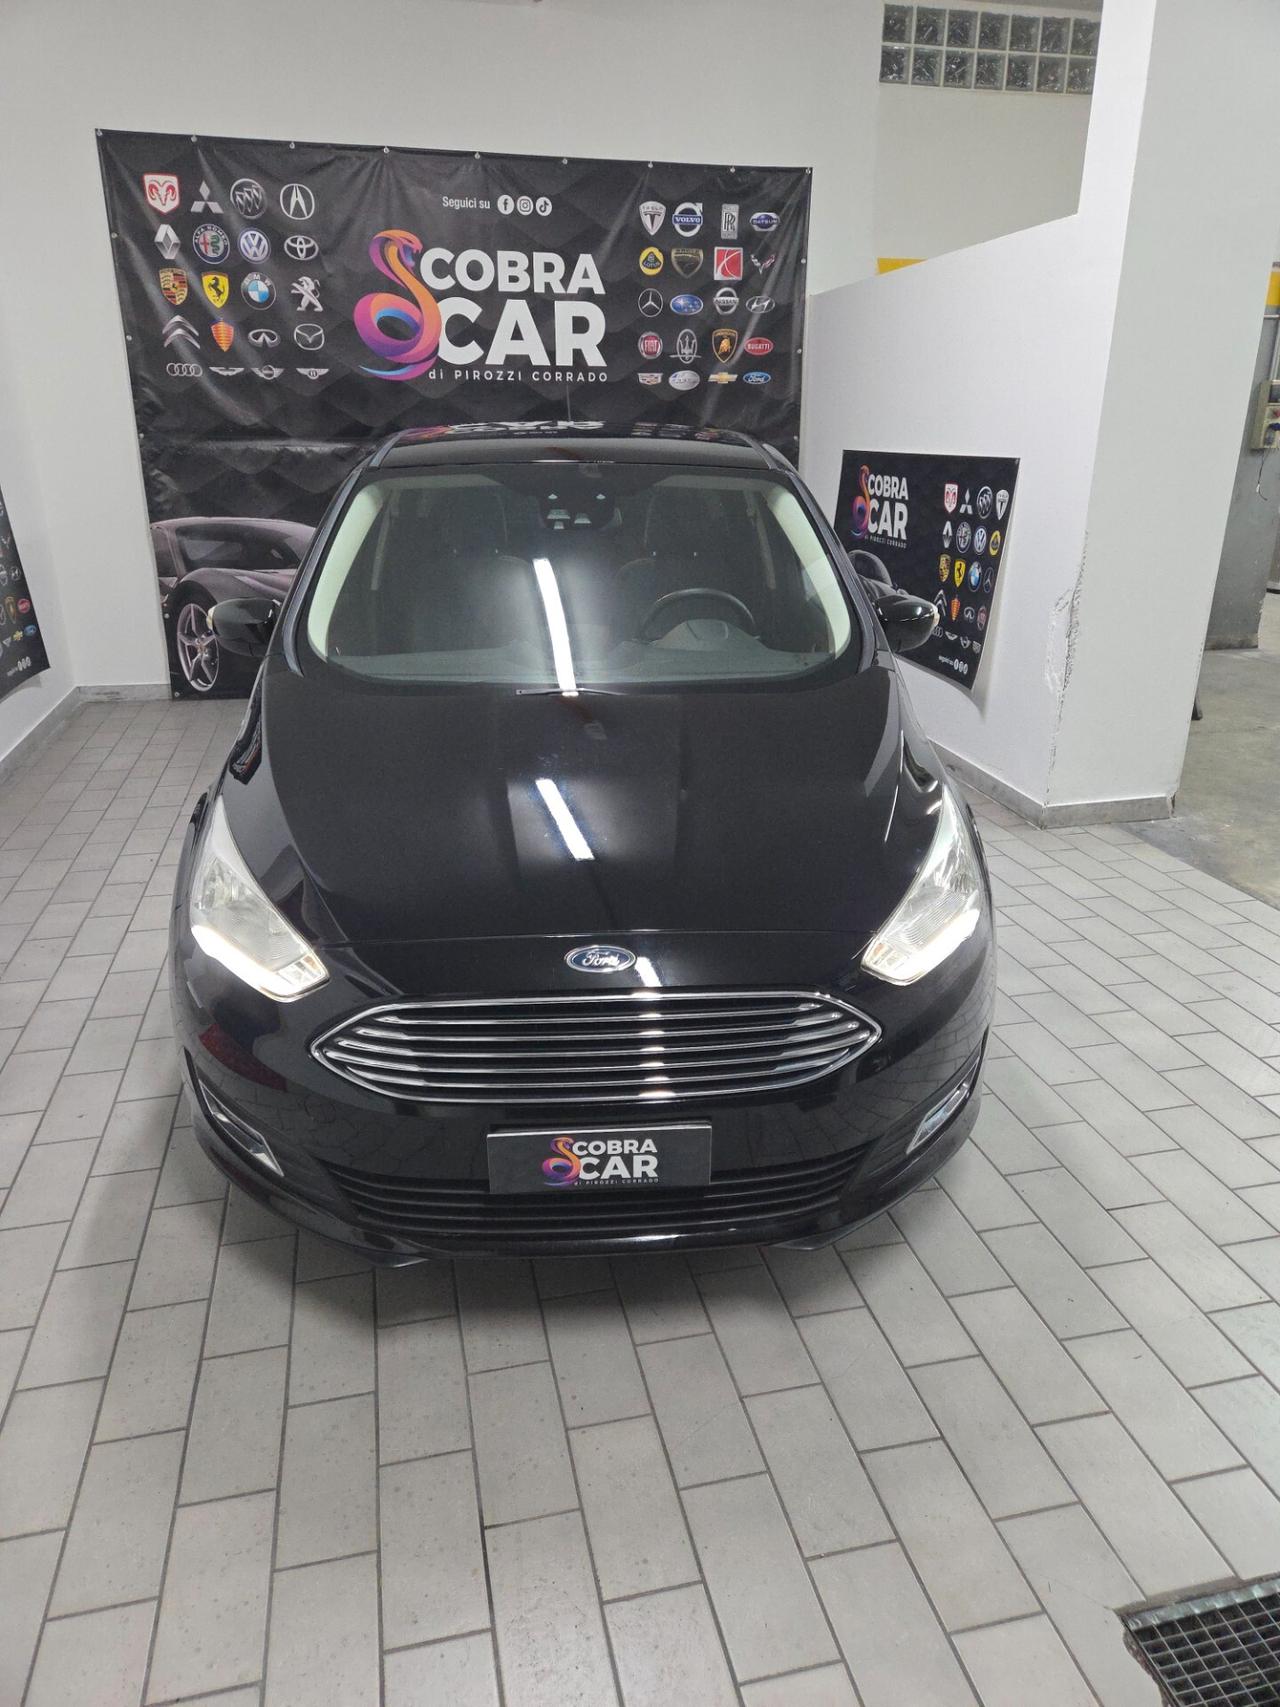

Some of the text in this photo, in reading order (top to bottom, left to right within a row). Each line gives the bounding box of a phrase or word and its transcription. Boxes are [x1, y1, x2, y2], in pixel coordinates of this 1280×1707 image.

[442, 196, 491, 210] Seguici su
[420, 247, 606, 294] COBRA
[437, 297, 607, 367] CAR
[747, 342, 770, 350] BUGATTI
[428, 369, 608, 382] di PIROZZI CORRADO
[868, 474, 909, 501] COBRA
[868, 498, 909, 541] CAR
[582, 950, 620, 968] Ford
[572, 1138, 658, 1156] COBRA
[579, 1155, 659, 1180] CAR
